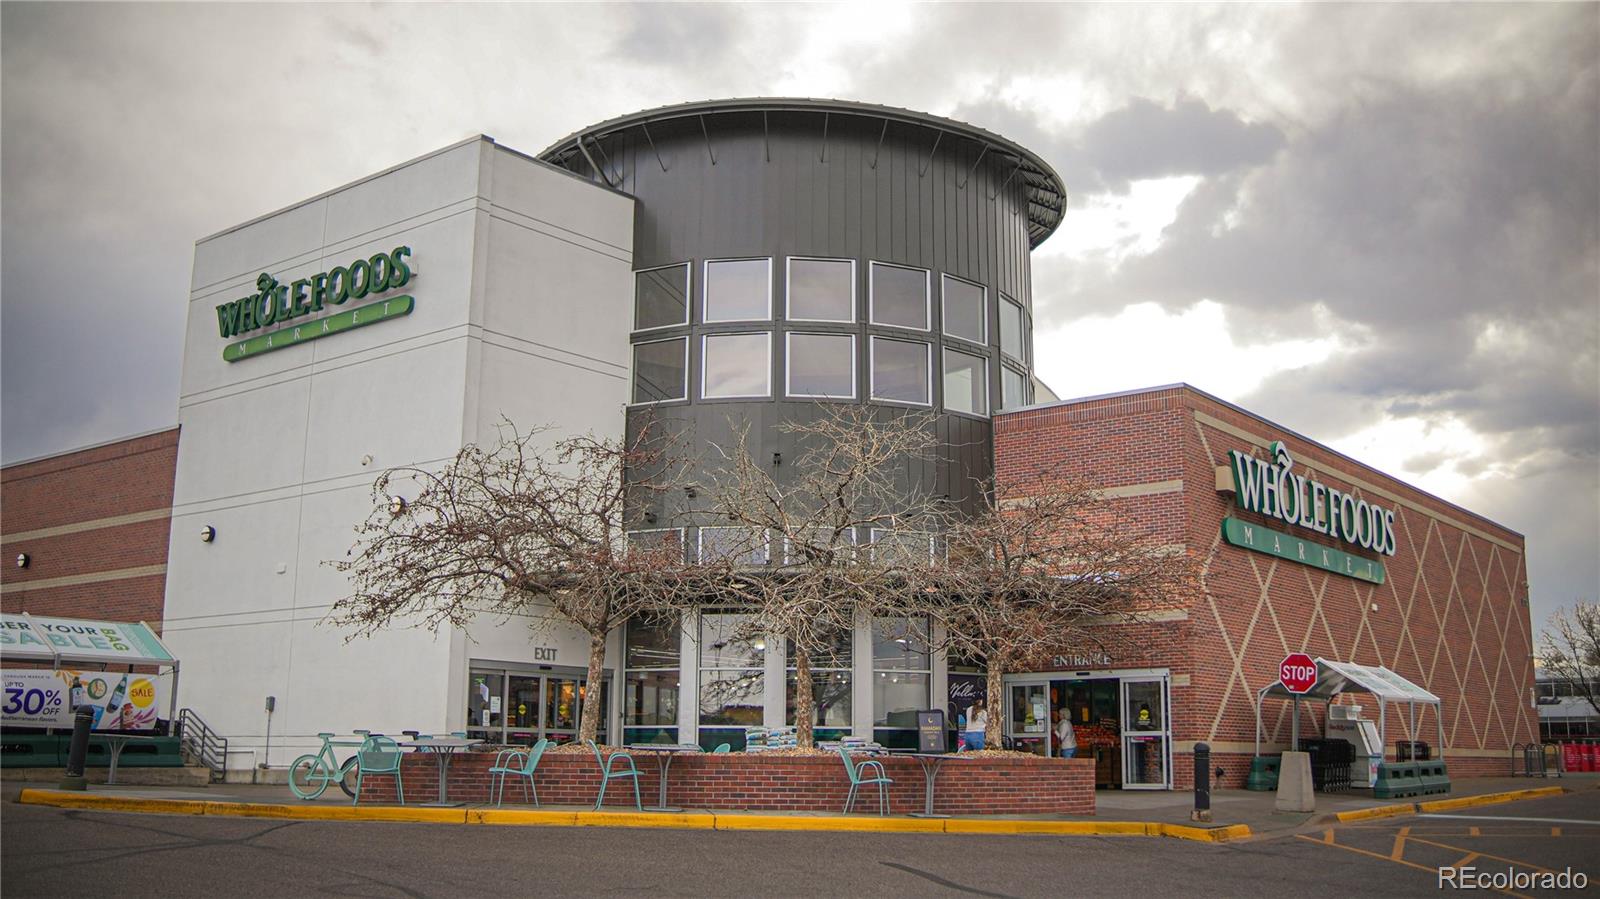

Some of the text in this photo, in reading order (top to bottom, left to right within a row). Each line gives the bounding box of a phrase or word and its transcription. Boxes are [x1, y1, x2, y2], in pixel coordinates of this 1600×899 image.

[239, 302, 390, 355] MARKET
[1244, 526, 1373, 577] MARKET
[41, 624, 98, 635] YOUR
[100, 627, 130, 651] BAG
[534, 647, 558, 661] EXIT
[1053, 653, 1111, 667] ENTRANCE
[1281, 665, 1315, 681] STOP
[131, 688, 153, 697] SALE
[2, 688, 62, 715] 30%
